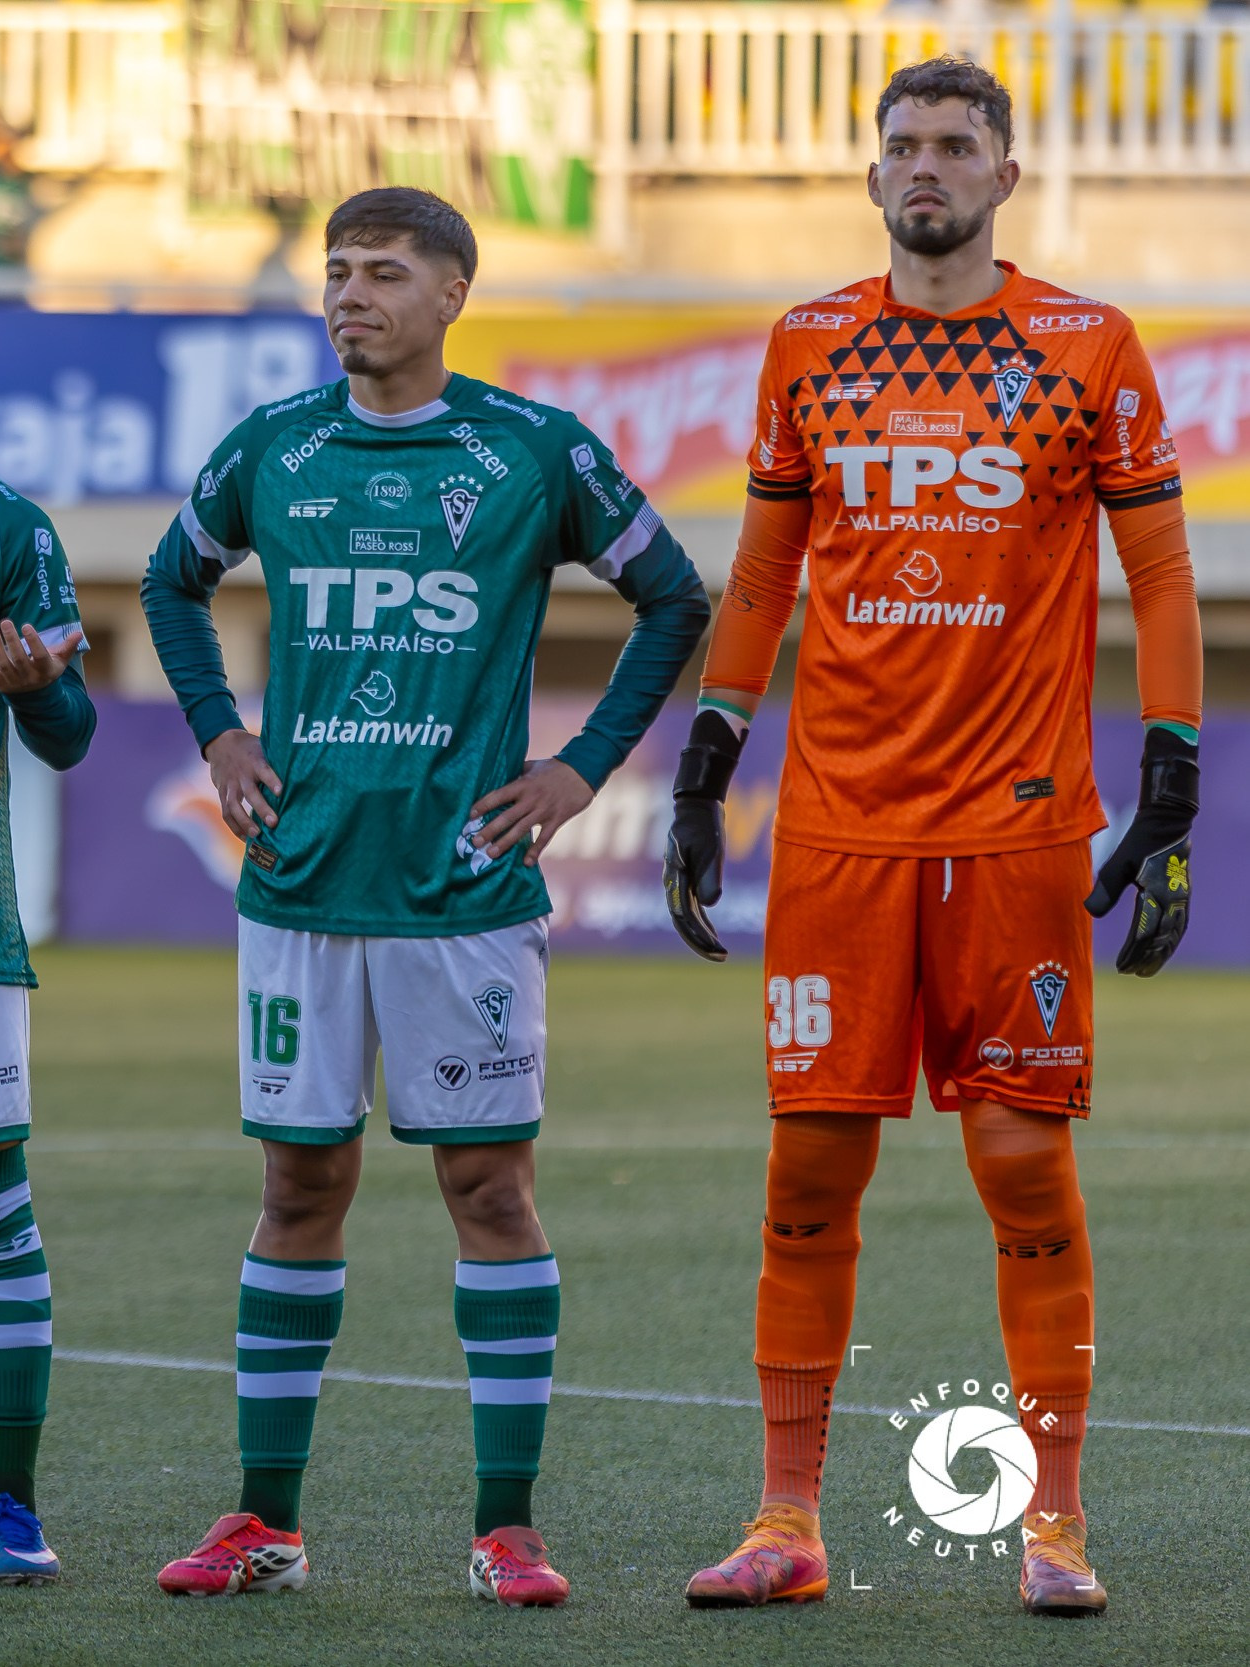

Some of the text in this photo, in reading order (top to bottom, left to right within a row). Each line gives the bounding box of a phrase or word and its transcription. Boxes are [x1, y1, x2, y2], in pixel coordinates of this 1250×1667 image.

[785, 323, 836, 332] Laboratorios
[1029, 326, 1083, 335] Laboratorios
[482, 393, 522, 415] Pullman
[894, 424, 957, 433] PASEO ROSS
[895, 415, 924, 425] MALL
[281, 421, 344, 474] Biozen
[449, 422, 509, 481] Biozen
[825, 446, 1025, 509] TPS
[374, 485, 404, 498] 1892
[289, 502, 335, 518] KS7
[849, 511, 1001, 533] VALPARAÍSO
[355, 532, 383, 542] MALL
[355, 542, 414, 552] PASEO ROSS
[289, 568, 479, 633] TPS
[846, 594, 1006, 627] Latamwin
[307, 634, 455, 655] VALPARAÍSO
[292, 714, 453, 748] Latamwin
[768, 974, 832, 1049] 36
[248, 989, 302, 1067] 16
[1021, 1046, 1083, 1059] FOTON
[478, 1053, 535, 1074] FOTON
[479, 1070, 517, 1082] CAMIONES
